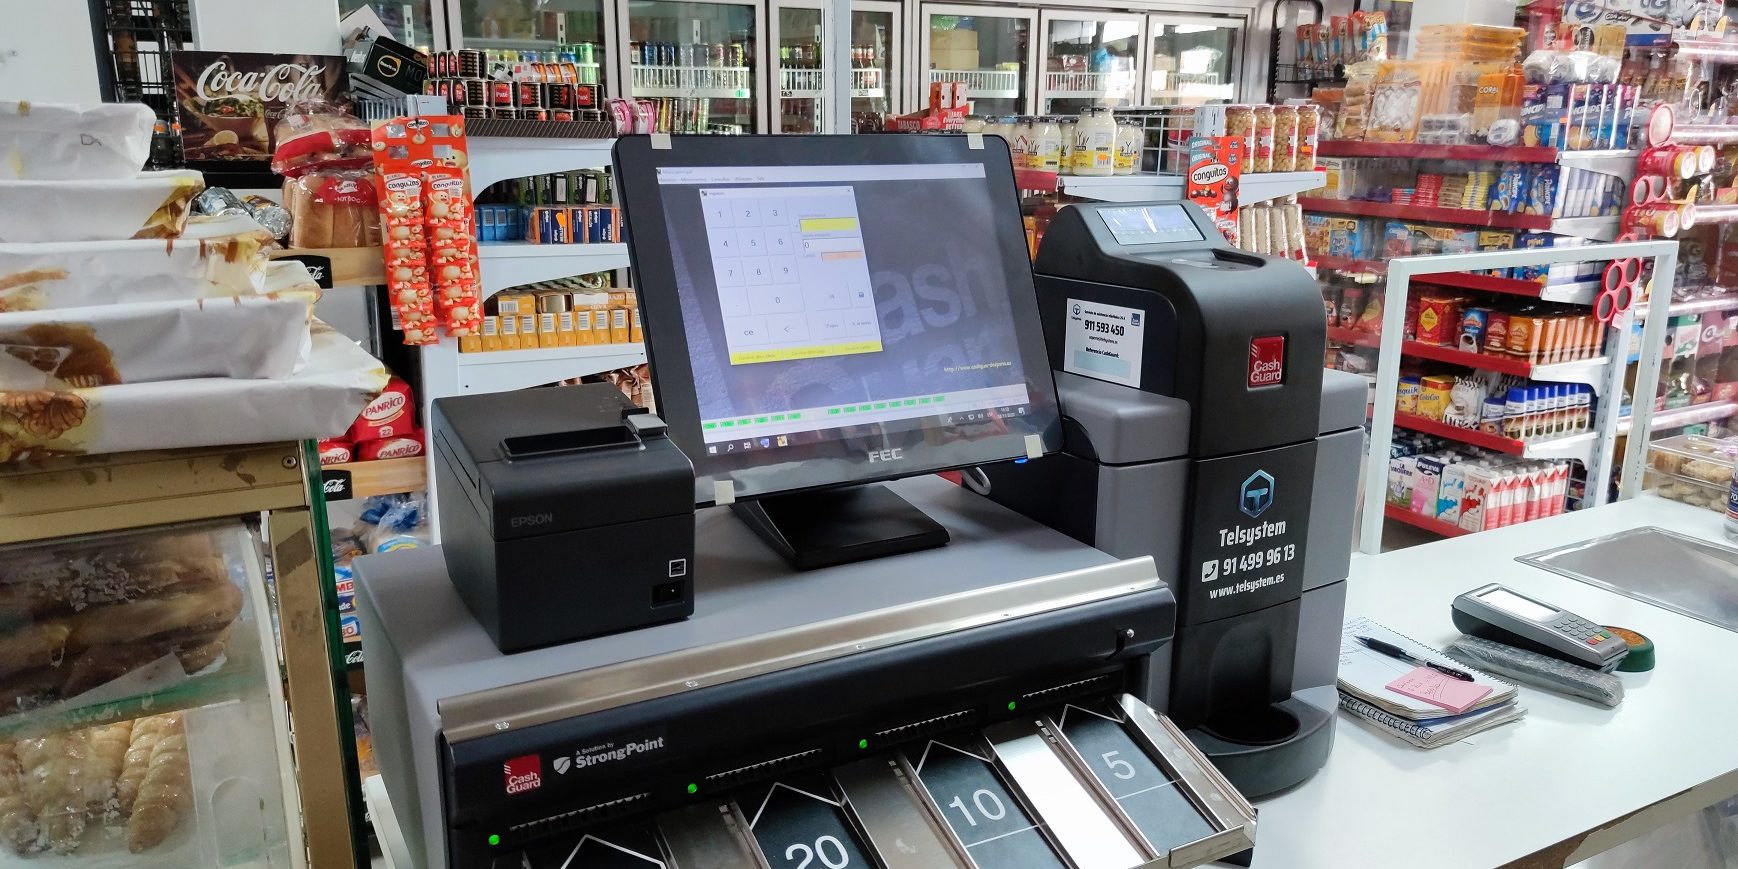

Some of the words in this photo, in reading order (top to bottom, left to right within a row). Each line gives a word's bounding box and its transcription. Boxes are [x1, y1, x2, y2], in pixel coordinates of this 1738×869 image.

[196, 62, 326, 102] Coca-Cola
[1194, 167, 1227, 182] conguitos
[1085, 320, 1095, 331] 911
[1096, 322, 1109, 334] 593
[1111, 325, 1124, 336] 450
[1254, 359, 1280, 371] Cash
[1251, 370, 1282, 382] Guard
[365, 396, 404, 416] PANRICO
[868, 448, 904, 463] FEC
[511, 513, 553, 528] EPSON
[1219, 520, 1286, 547] Telsystem
[1223, 558, 1237, 576] 91
[1239, 551, 1264, 572] 499
[1267, 548, 1281, 566] 96
[1283, 544, 1296, 561] 13
[1209, 573, 1285, 599] www.telsystem.es
[576, 736, 664, 769] StrongPoint
[582, 744, 606, 754] Solution
[1102, 750, 1135, 780] 5
[506, 777, 541, 794] Guard
[508, 772, 538, 785] Cash
[948, 789, 1006, 826] 10
[785, 835, 849, 869] 20
